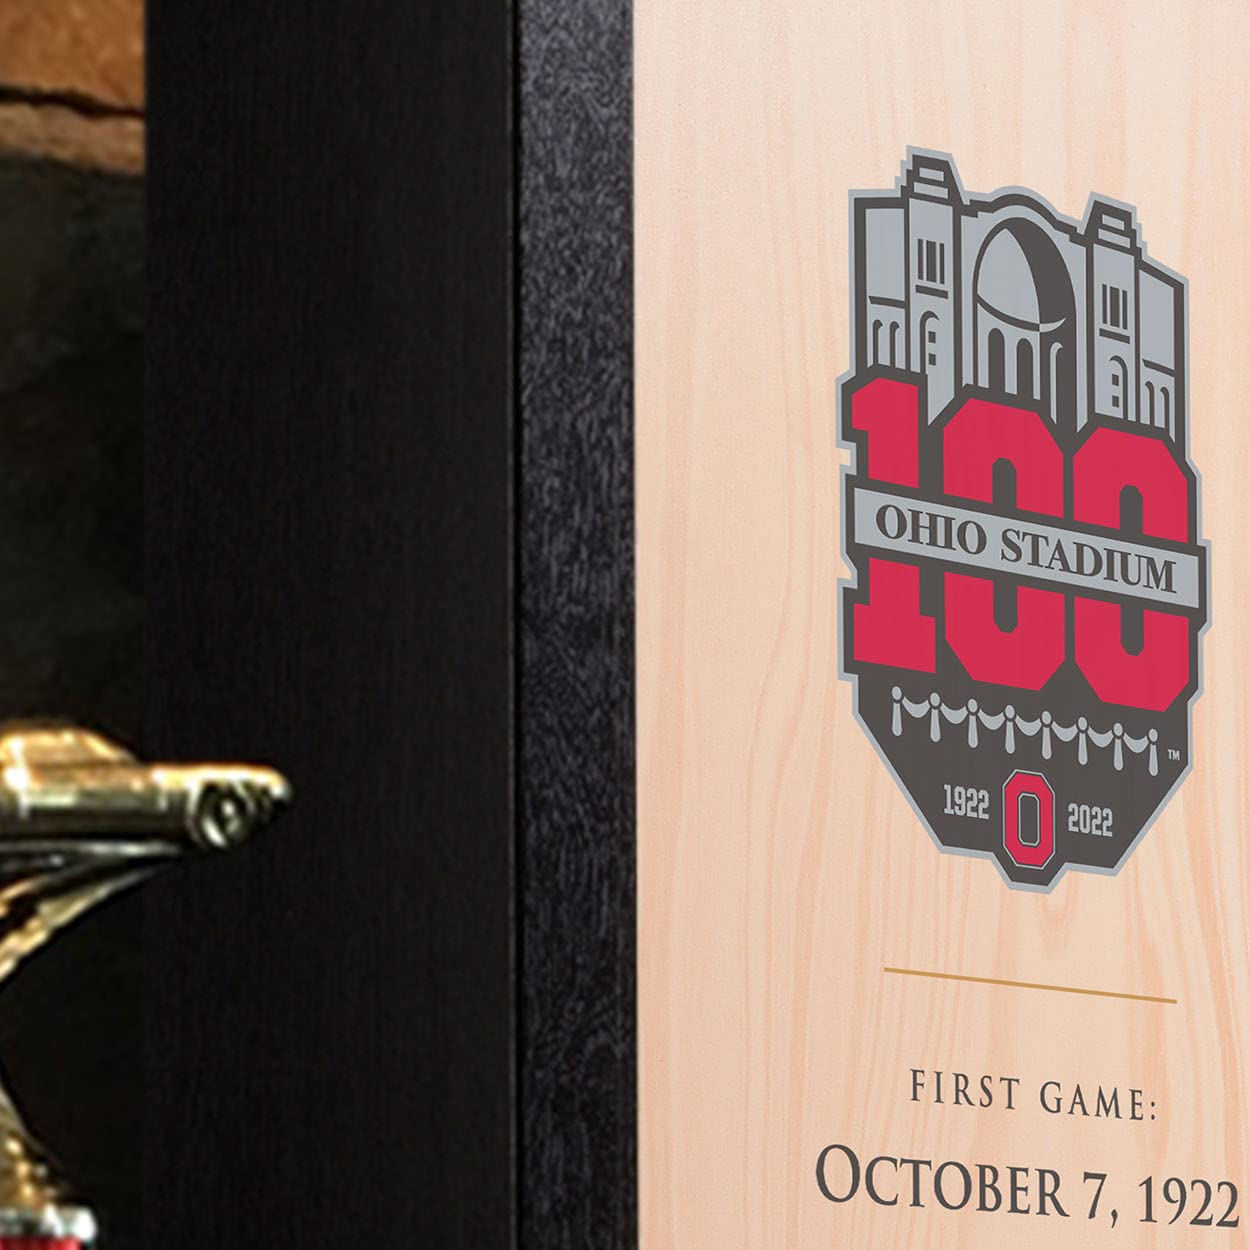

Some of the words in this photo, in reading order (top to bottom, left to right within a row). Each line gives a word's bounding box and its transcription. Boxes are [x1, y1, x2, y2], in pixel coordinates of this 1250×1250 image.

[852, 377, 1189, 712] 100
[876, 504, 987, 554] OHIO
[1001, 527, 1177, 594] STADIUM
[943, 784, 989, 820] 1922
[1068, 803, 1113, 837] 2022
[910, 1068, 1020, 1110] FIRST
[1040, 1081, 1156, 1121] GAME:
[815, 1143, 1070, 1217] OCTOBER
[1083, 1171, 1118, 1229] 7,
[1137, 1175, 1240, 1228] 1922
